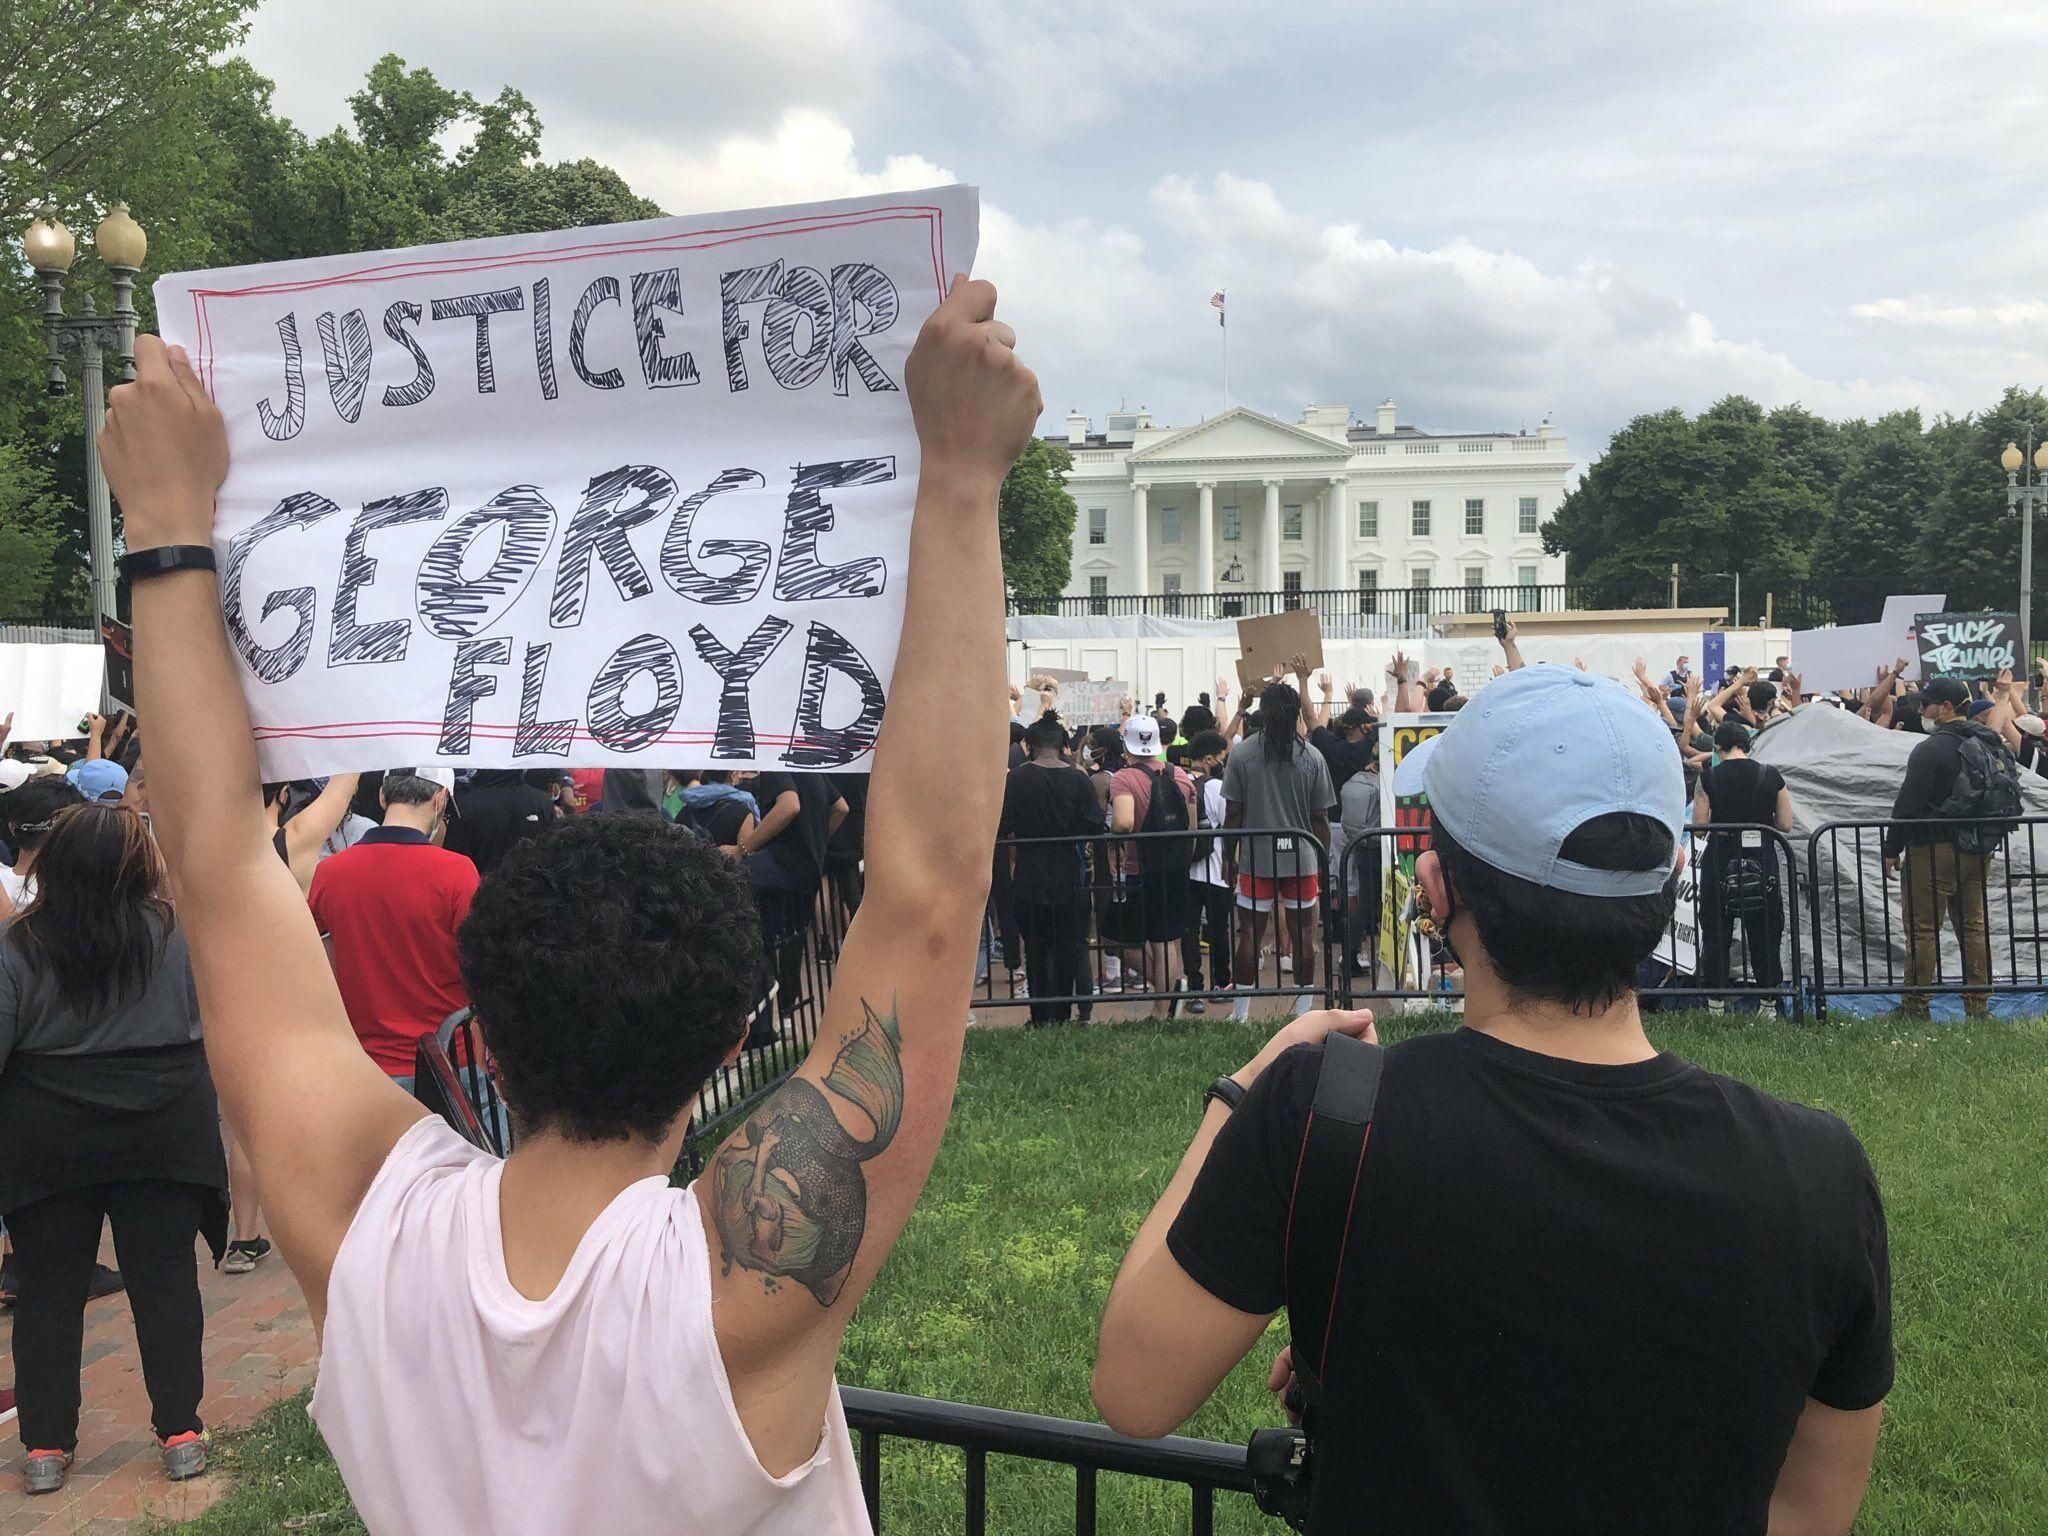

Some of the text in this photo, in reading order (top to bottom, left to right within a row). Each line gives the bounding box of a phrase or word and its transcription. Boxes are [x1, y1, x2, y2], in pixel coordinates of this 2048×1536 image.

[257, 259, 900, 441] JUSTICE FOR
[223, 456, 897, 685] GEORGE
[1920, 619, 2006, 647] FUCK
[436, 615, 887, 770] FLOYD
[1276, 837, 1293, 850] PRPA
